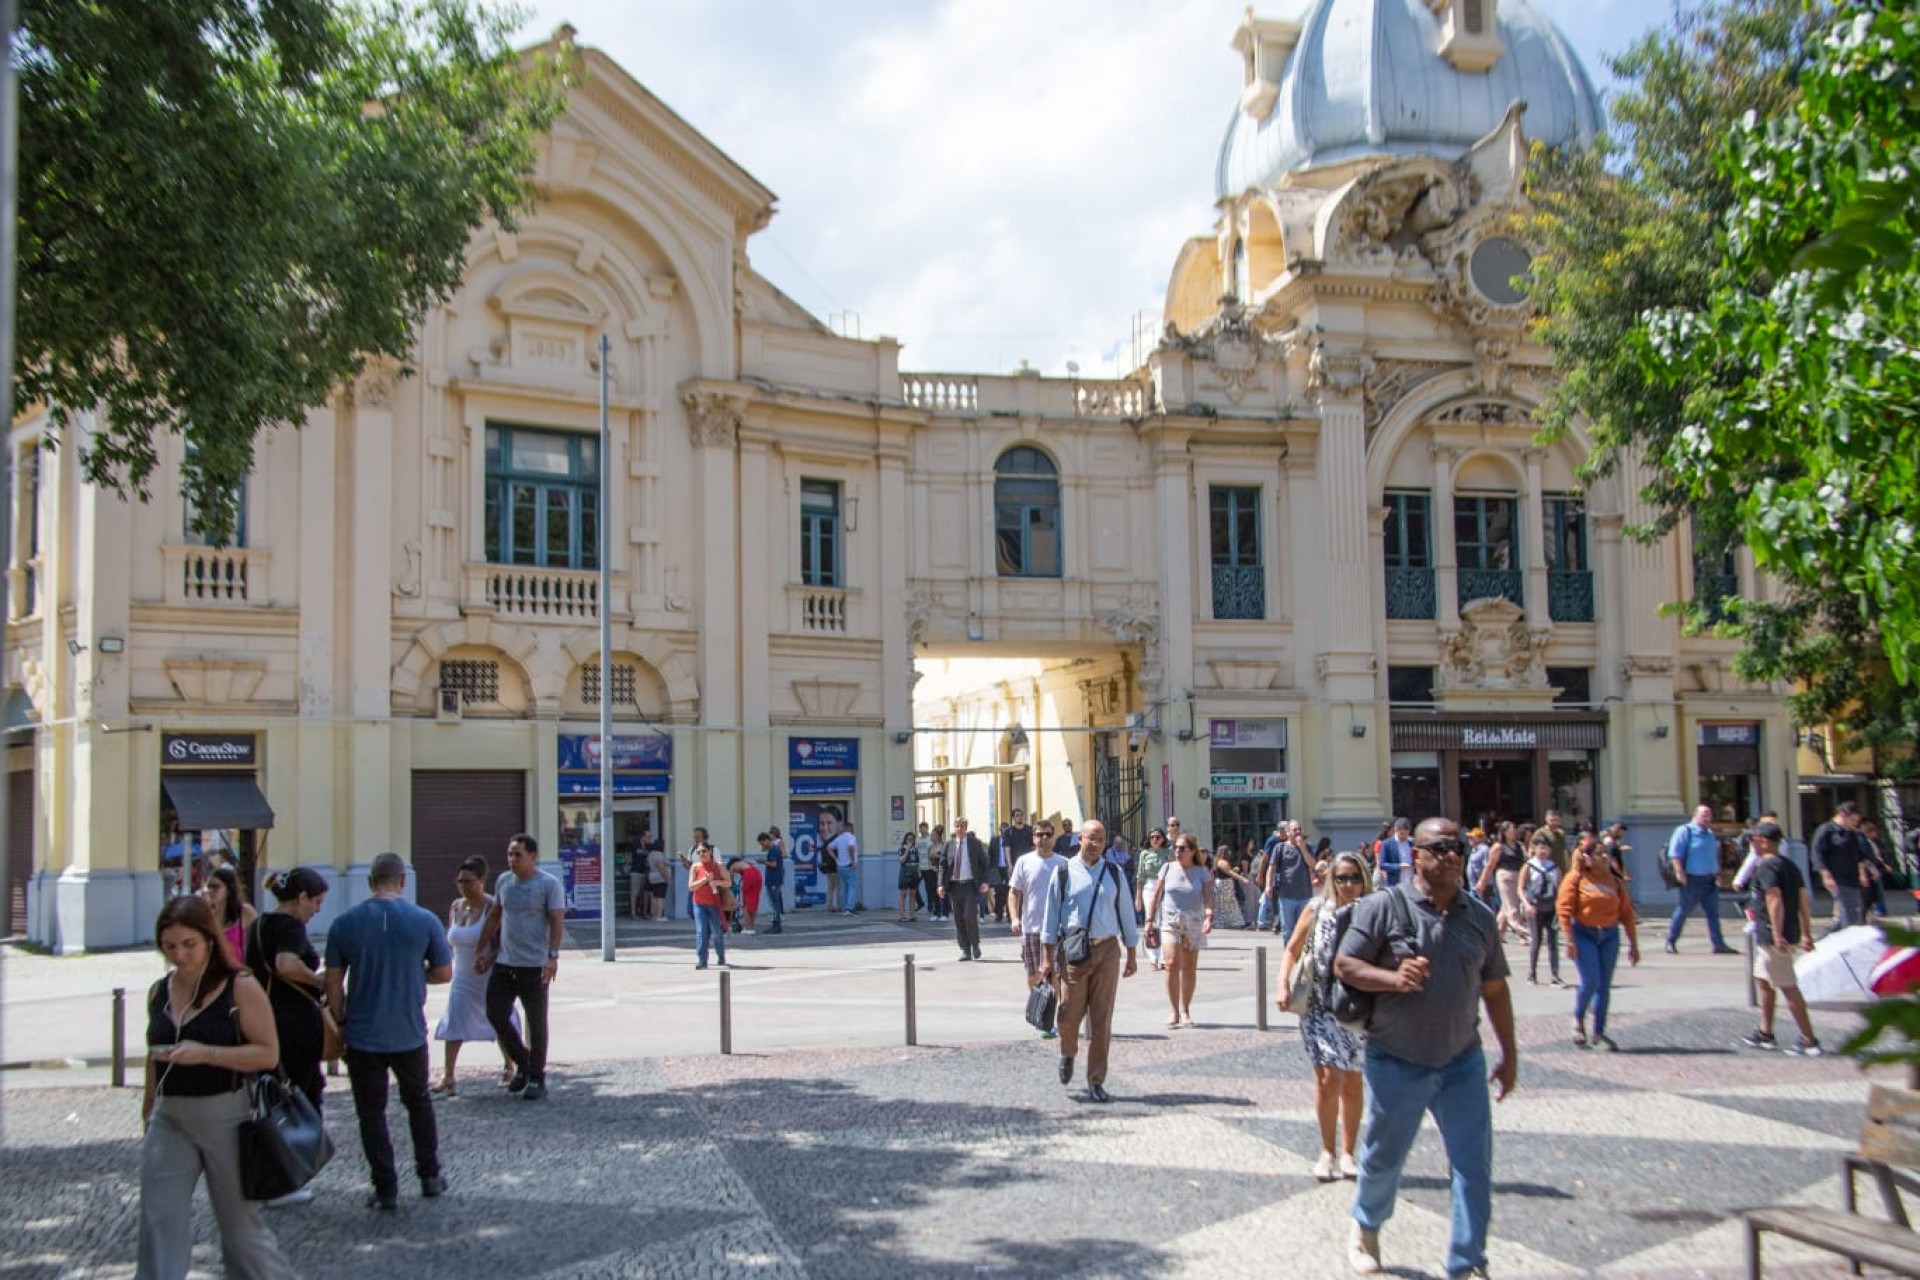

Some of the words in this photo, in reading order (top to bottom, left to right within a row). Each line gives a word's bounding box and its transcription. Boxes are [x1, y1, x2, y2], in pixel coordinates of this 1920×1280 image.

[1463, 729, 1487, 743] Rei
[1500, 729, 1536, 743] Mate
[814, 743, 849, 753] precisão
